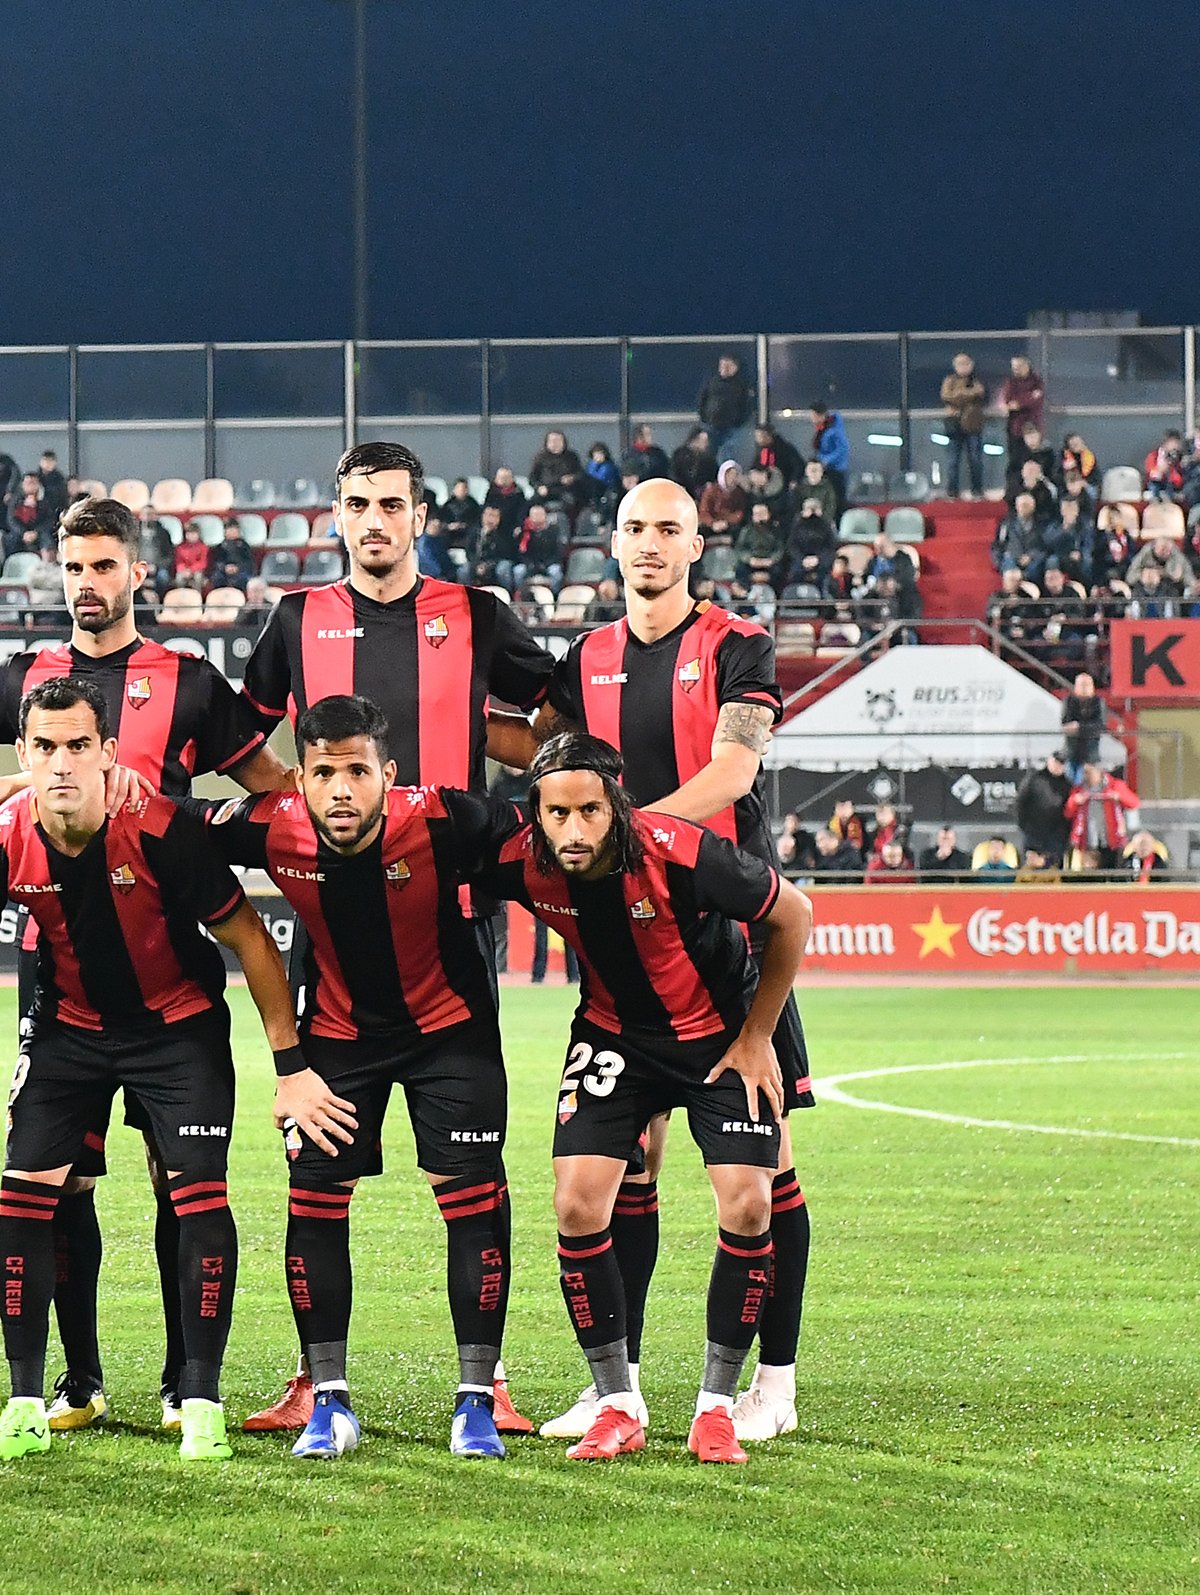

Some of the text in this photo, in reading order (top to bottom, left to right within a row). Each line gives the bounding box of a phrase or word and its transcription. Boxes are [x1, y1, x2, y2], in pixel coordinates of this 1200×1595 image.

[317, 627, 364, 639] KELME
[1131, 633, 1186, 686] K
[591, 673, 628, 684] KELME
[14, 883, 63, 893] KELME
[277, 866, 325, 881] KELME
[533, 900, 579, 916] KELME
[966, 907, 1138, 957] Estrella
[560, 1043, 625, 1096] 23
[179, 1125, 227, 1137] KELME
[451, 1131, 500, 1142] KELME
[722, 1121, 773, 1136] KELME
[6, 1257, 23, 1316] CF REUS
[200, 1256, 223, 1318] CF REUS
[480, 1248, 502, 1311] CF REUS
[564, 1272, 594, 1329] CF REUS
[740, 1270, 767, 1324] CF REUS
